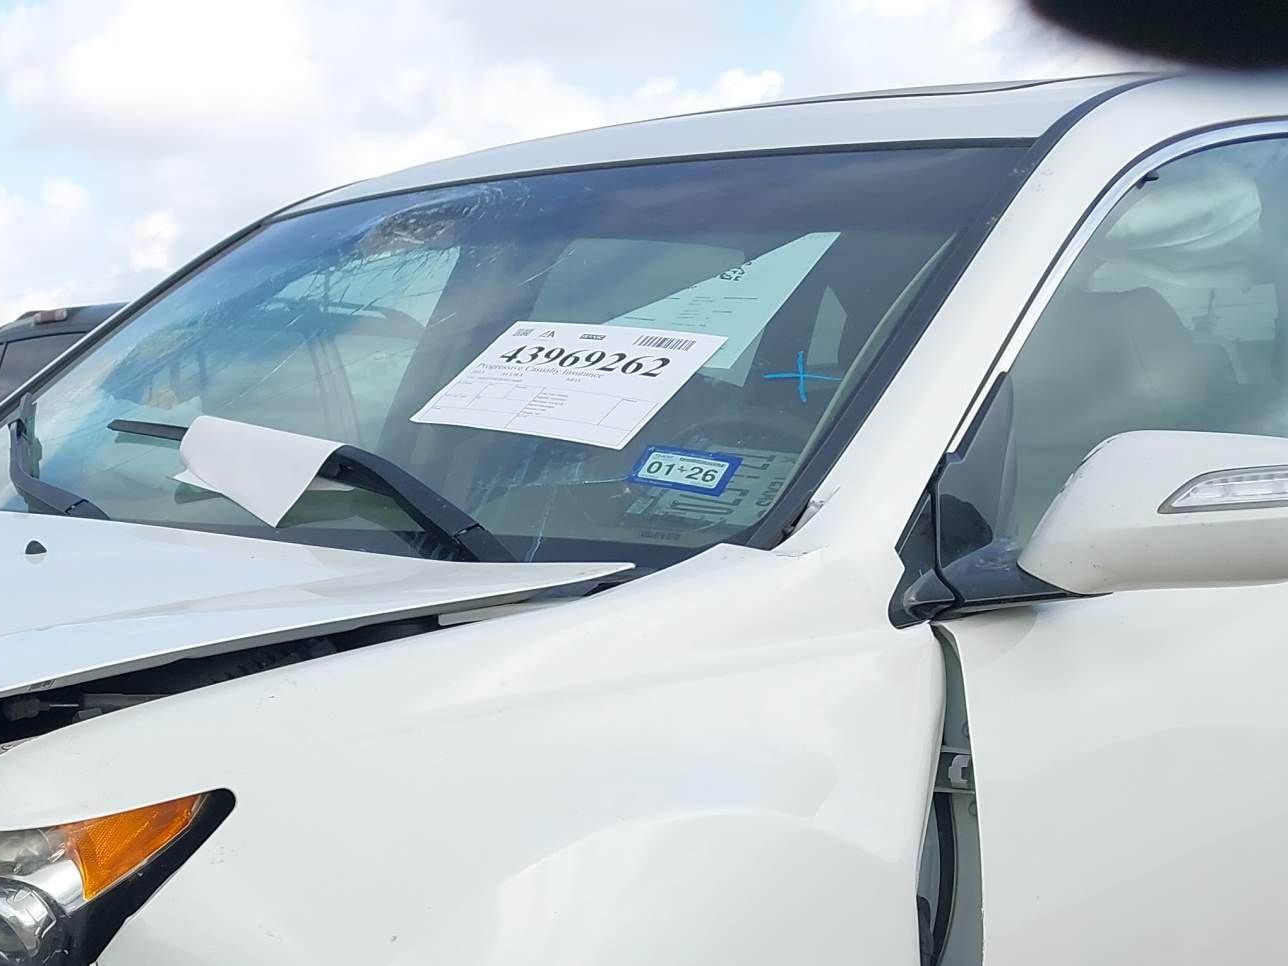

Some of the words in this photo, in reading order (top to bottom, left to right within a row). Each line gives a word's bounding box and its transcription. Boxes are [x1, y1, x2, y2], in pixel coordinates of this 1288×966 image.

[499, 344, 671, 378] 43969262
[646, 460, 676, 476] 01
[685, 466, 719, 483] 26
